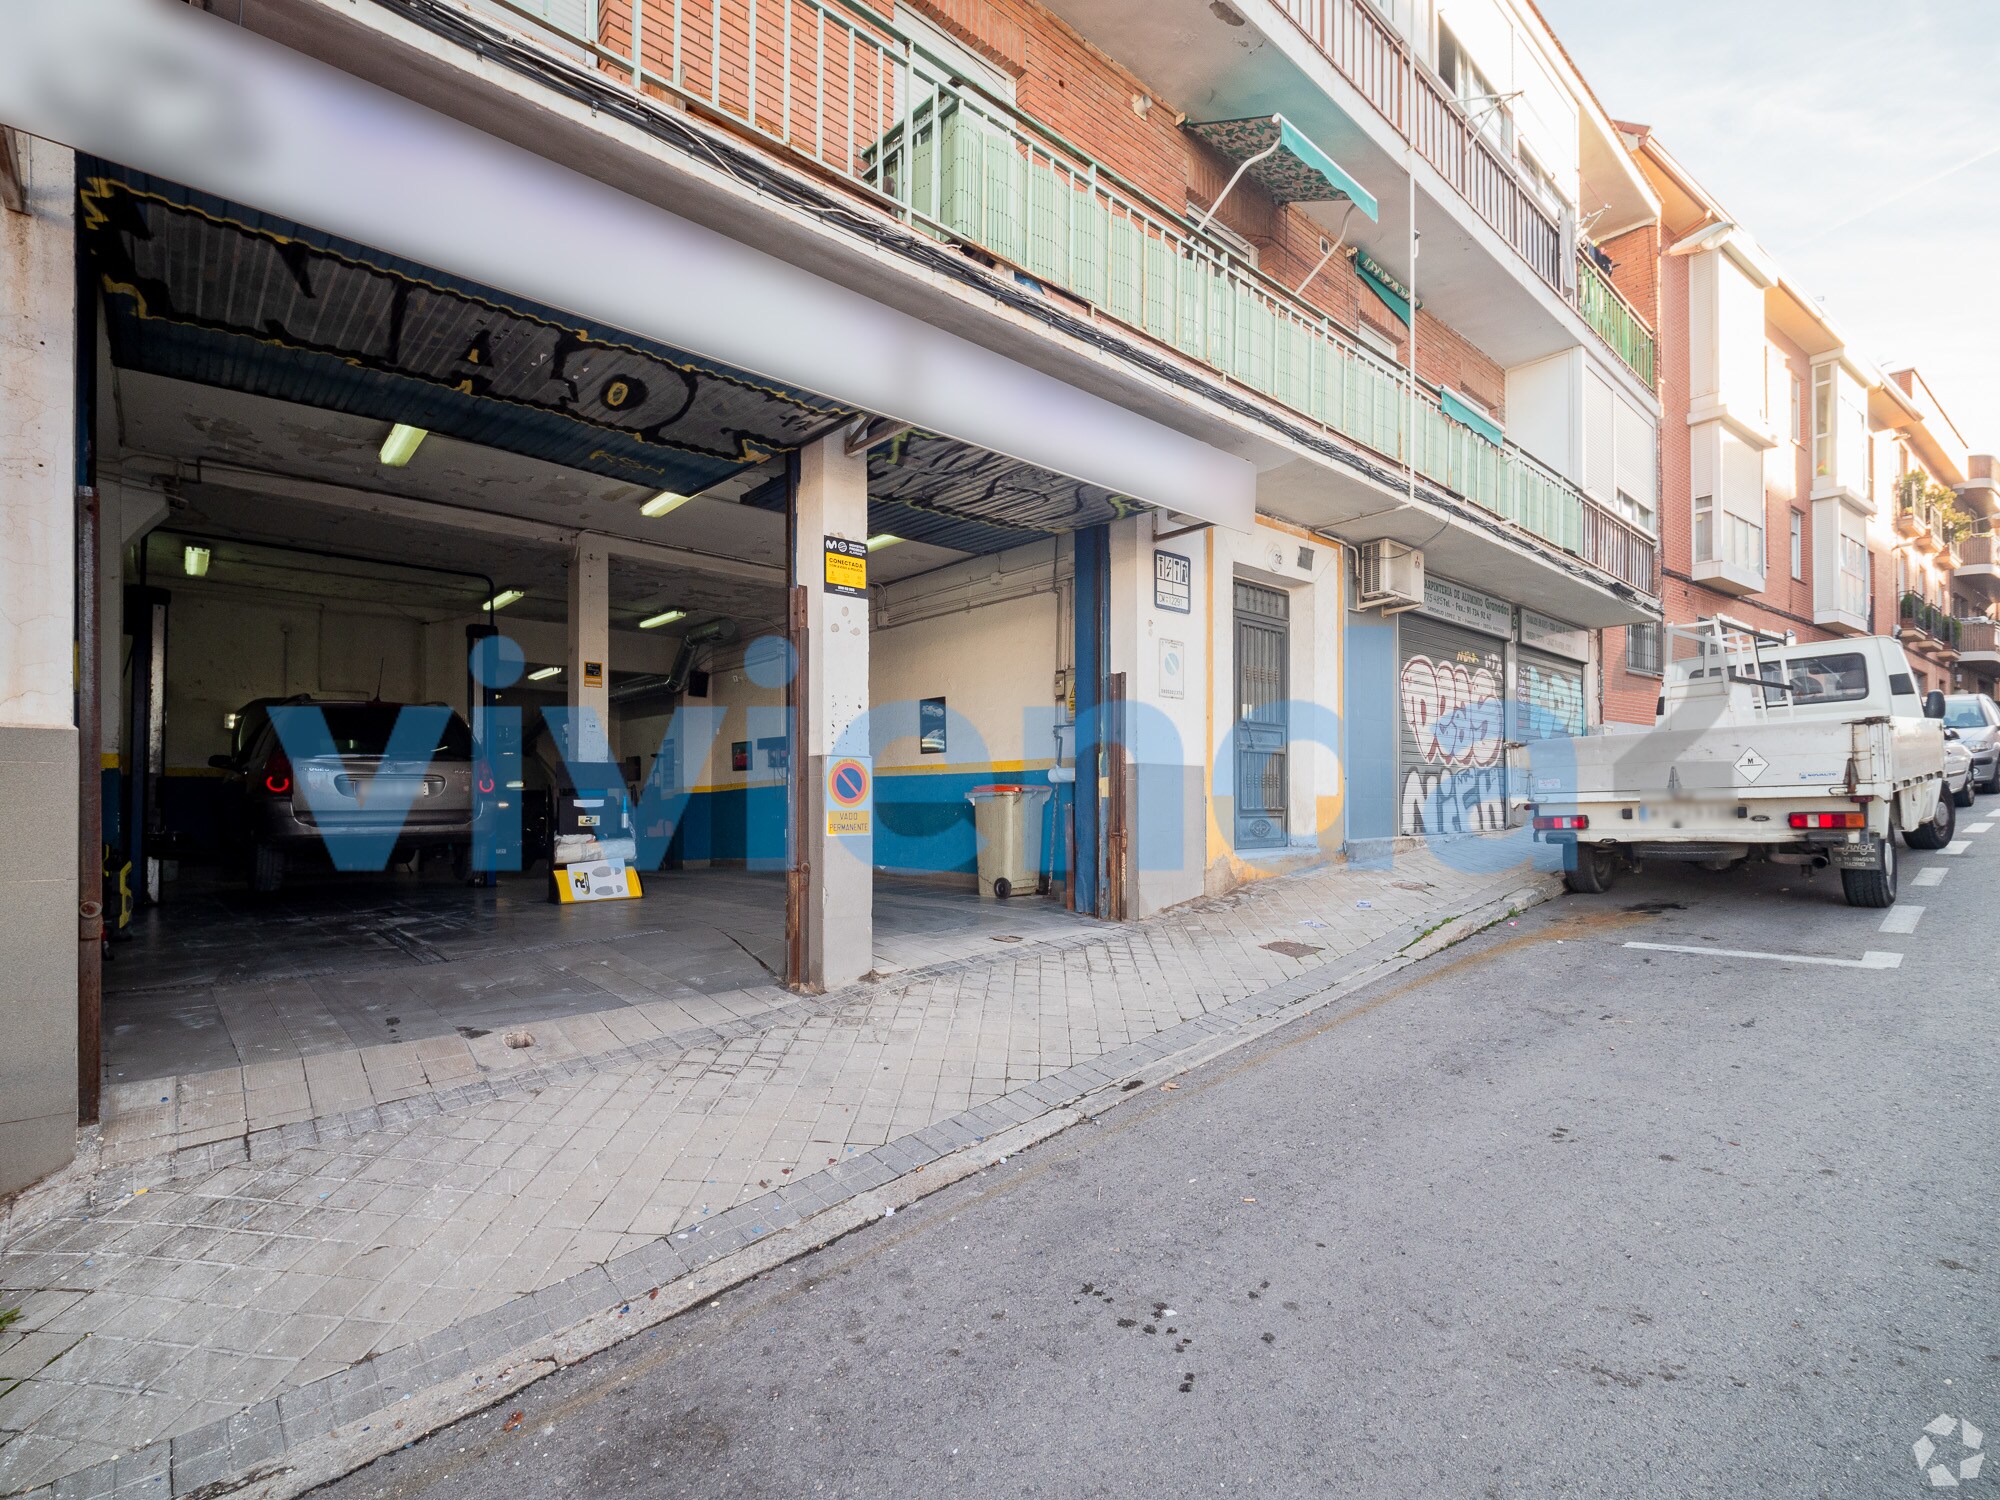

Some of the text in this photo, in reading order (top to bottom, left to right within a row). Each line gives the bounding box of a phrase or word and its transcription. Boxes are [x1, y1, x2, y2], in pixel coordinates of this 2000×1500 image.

[829, 557, 863, 569] CONECTADA
[1454, 589, 1460, 600] DE
[1485, 597, 1509, 616] Granados
[840, 812, 858, 820] VADO
[829, 823, 868, 831] PERMANENTE
